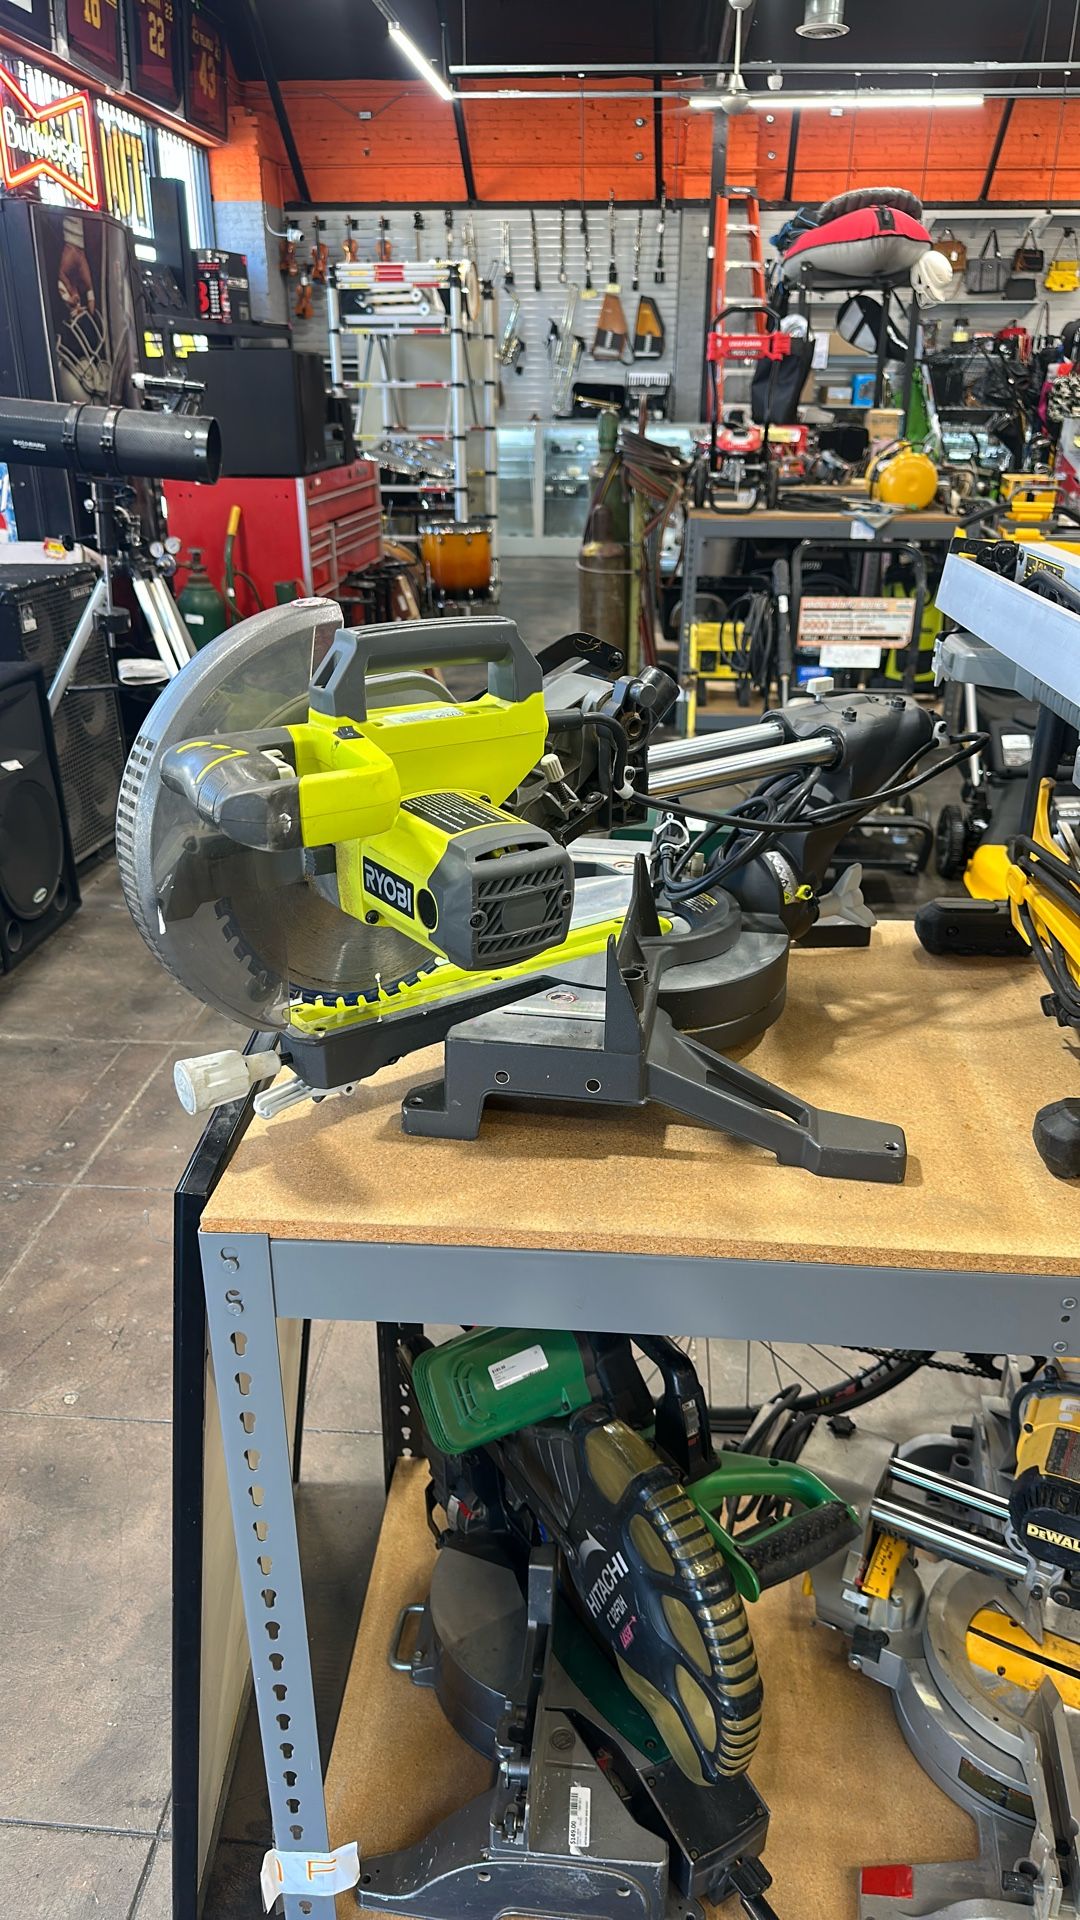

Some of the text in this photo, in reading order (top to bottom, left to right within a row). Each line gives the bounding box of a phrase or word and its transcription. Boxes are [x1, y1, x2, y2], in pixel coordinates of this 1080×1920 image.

[148, 11, 166, 59] 22
[200, 52, 217, 99] 43
[2, 106, 83, 174] Budweiser
[364, 863, 412, 912] RYOBI
[586, 1551, 629, 1618] HITACHI
[307, 1858, 336, 1881] F
